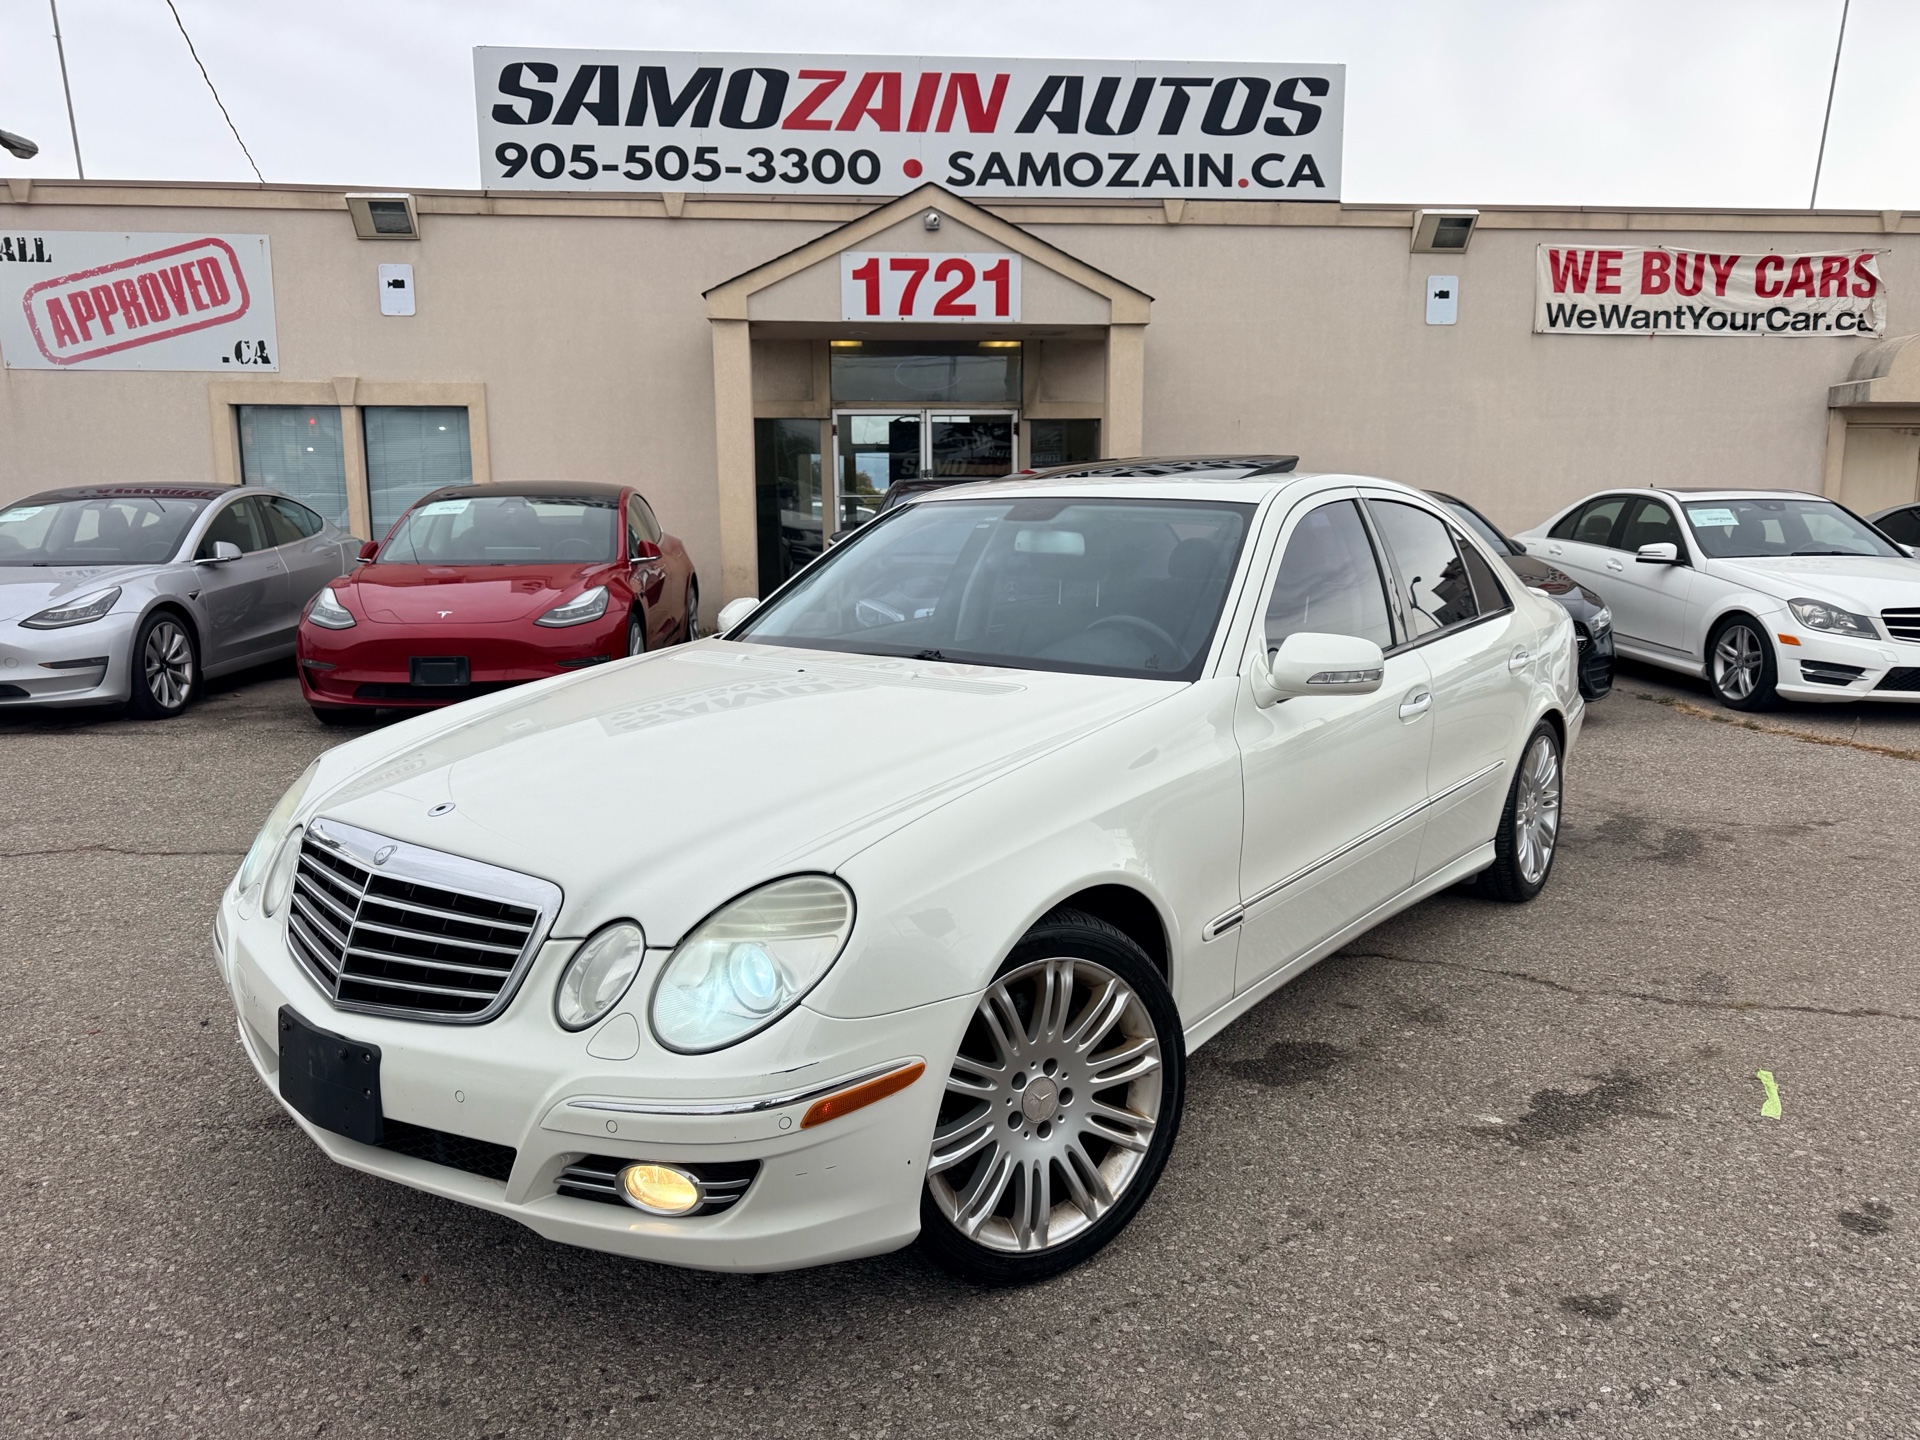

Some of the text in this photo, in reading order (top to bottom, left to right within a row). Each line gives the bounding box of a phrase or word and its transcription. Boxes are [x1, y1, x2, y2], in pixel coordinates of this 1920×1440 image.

[492, 62, 1329, 137] SAMOZAIN AUTOS
[495, 142, 1326, 189] 905-505-3300 SAMOZAIN.CA
[851, 257, 1010, 317] 1721
[1549, 249, 1877, 299] WE BUY CARS
[46, 256, 231, 348] APPROVED
[222, 340, 271, 365] .CA
